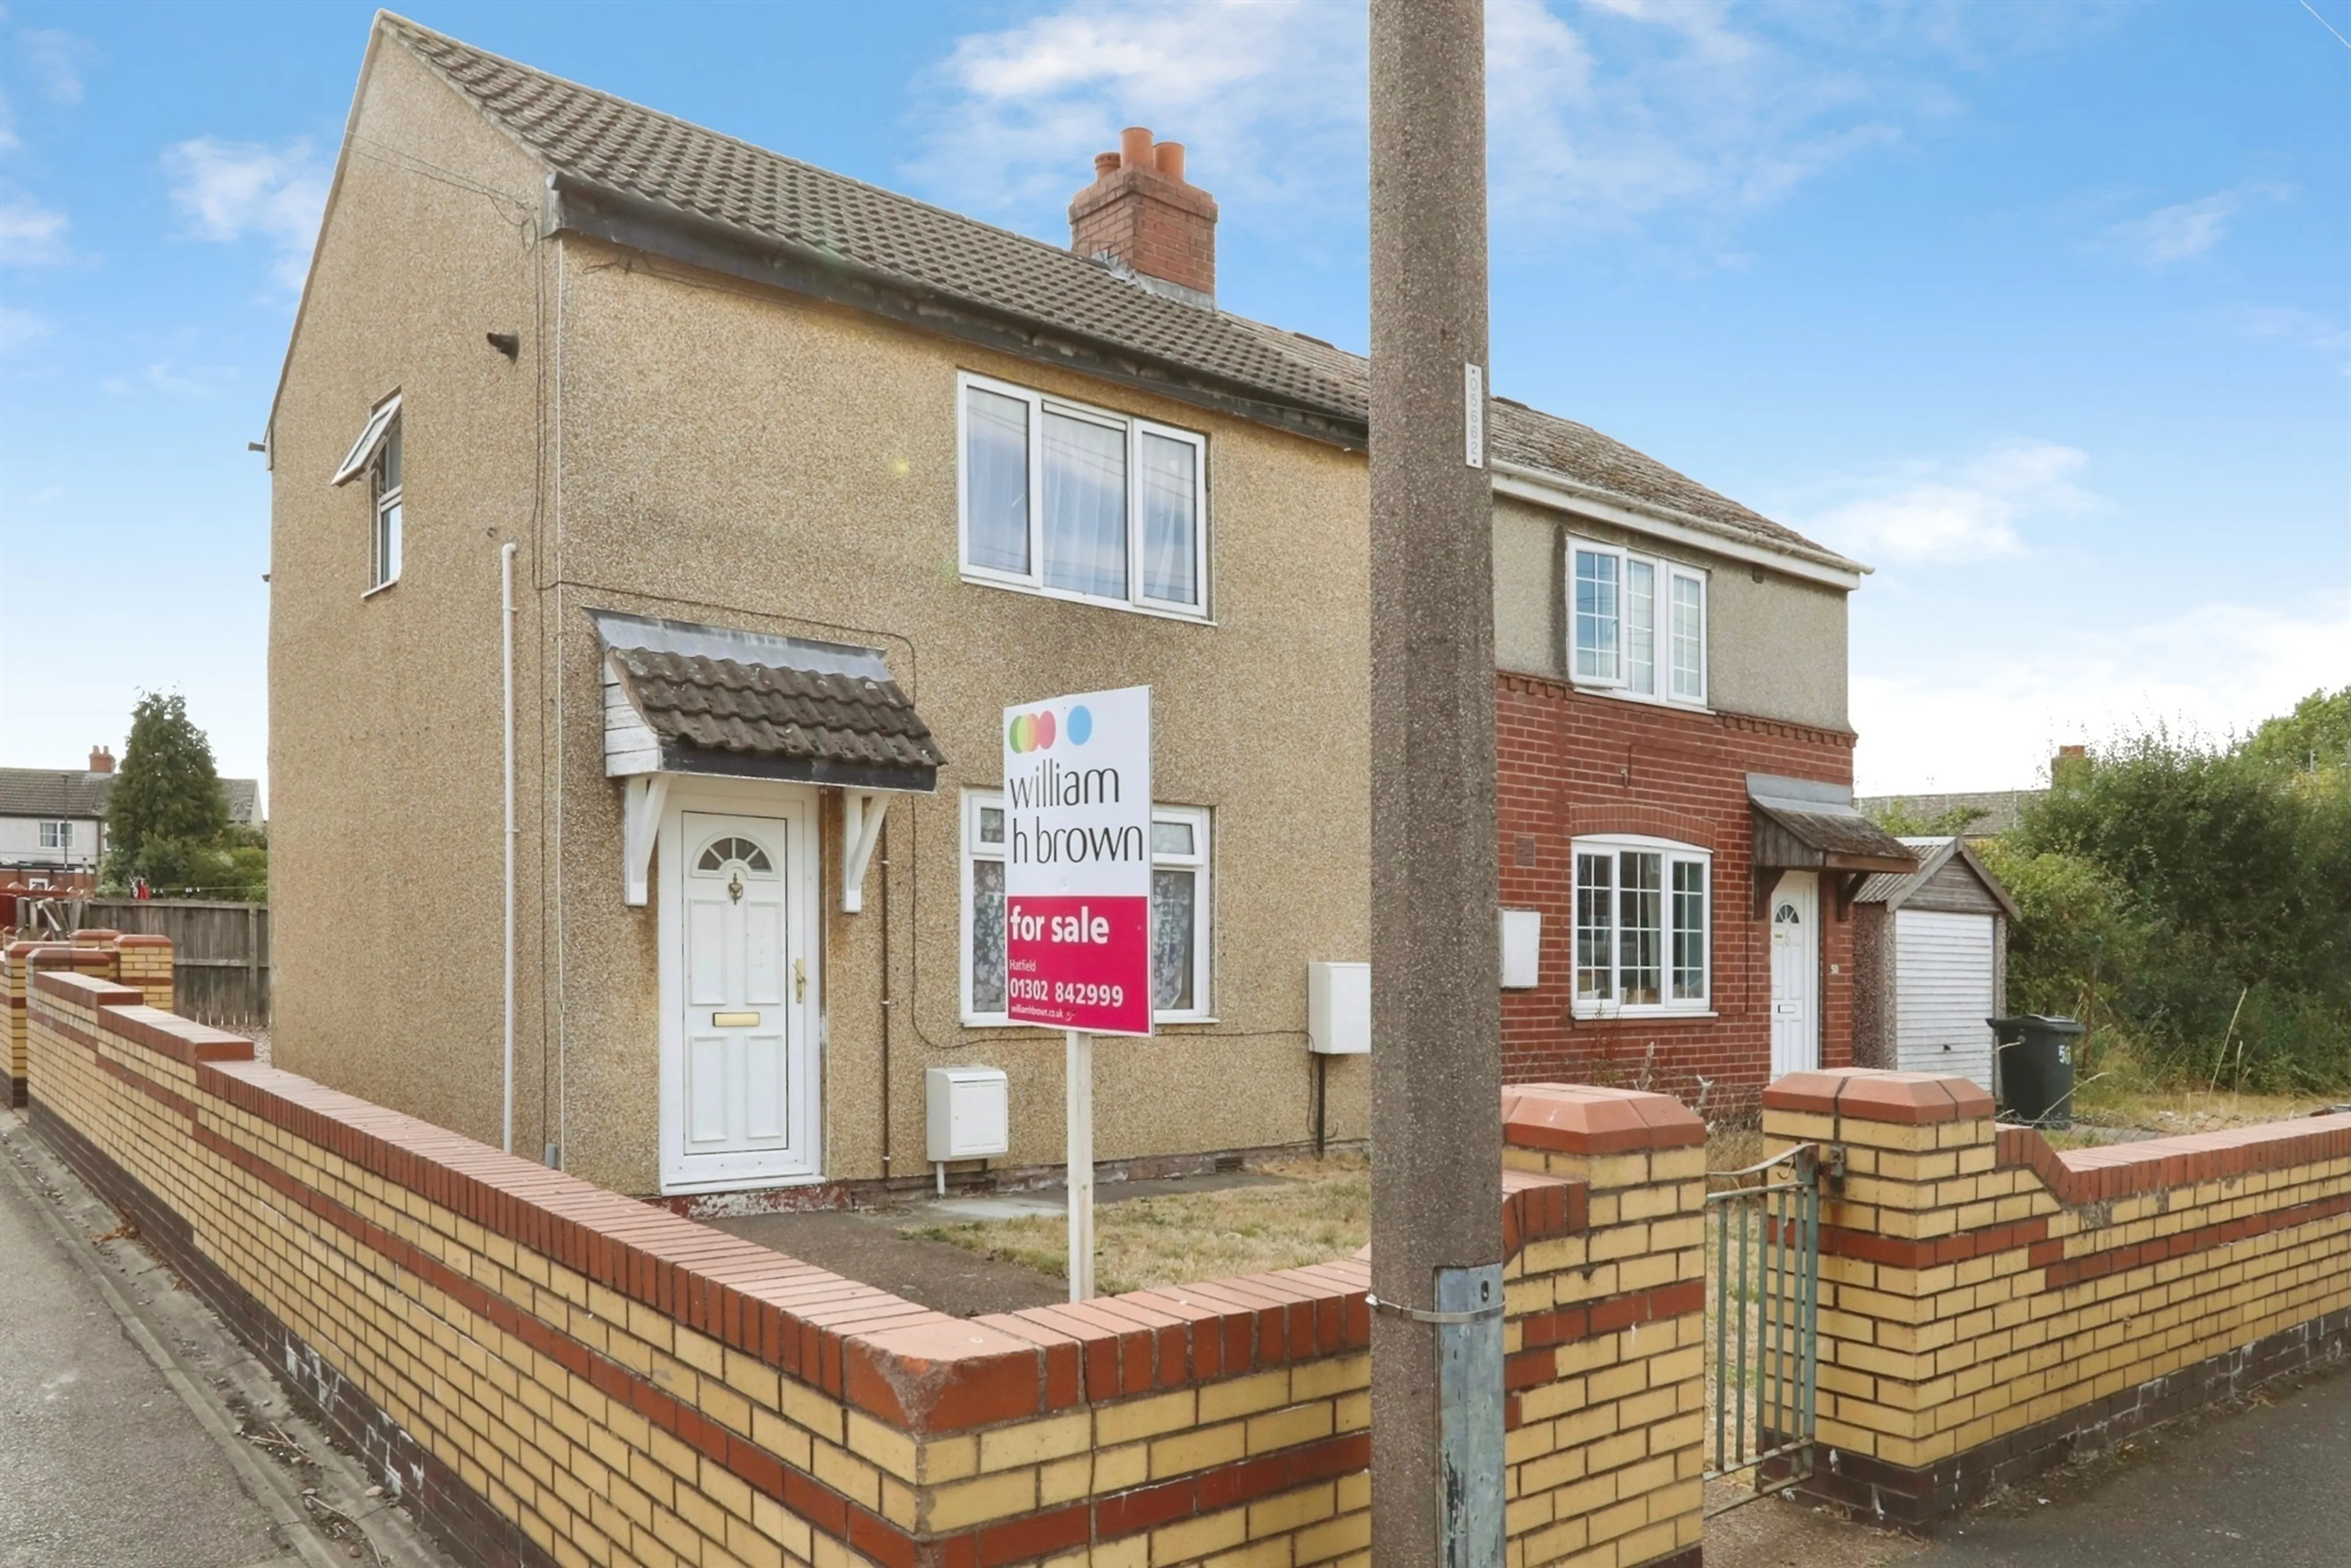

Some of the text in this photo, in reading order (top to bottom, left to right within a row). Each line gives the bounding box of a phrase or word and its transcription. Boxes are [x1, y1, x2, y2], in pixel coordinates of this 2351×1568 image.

[1010, 758, 1119, 809] william
[1013, 816, 1143, 864] h brown
[1010, 905, 1109, 944] for sale
[1009, 959, 1036, 972] Hatfield
[1010, 978, 1123, 1007] 01302 842999
